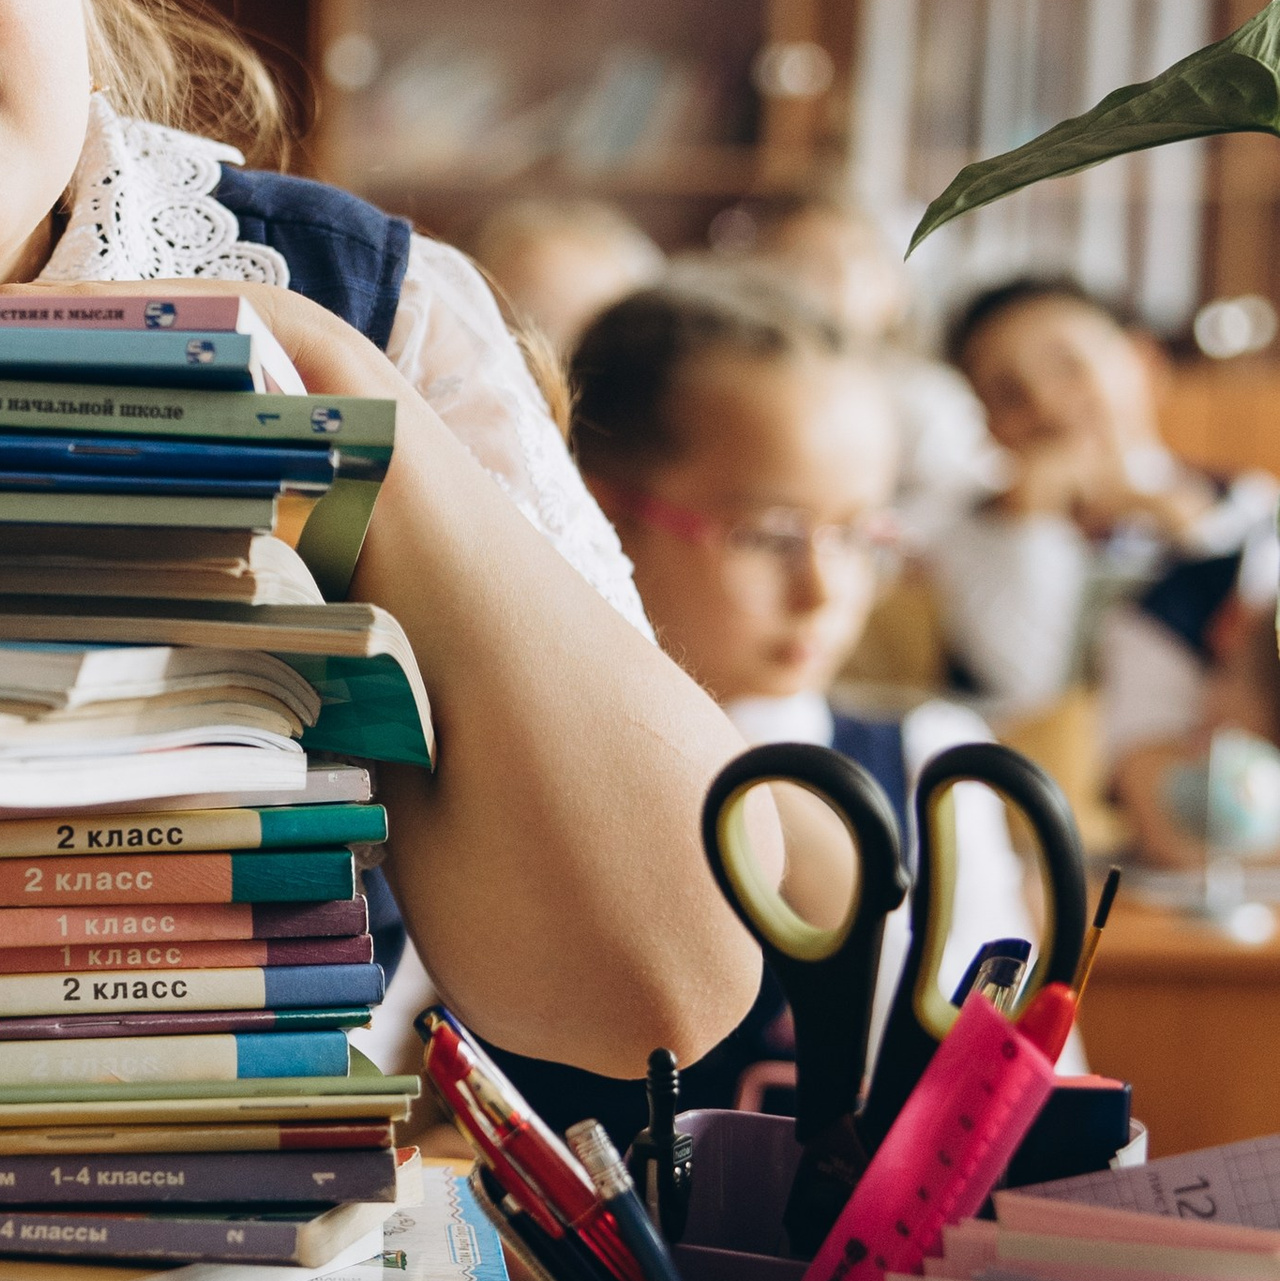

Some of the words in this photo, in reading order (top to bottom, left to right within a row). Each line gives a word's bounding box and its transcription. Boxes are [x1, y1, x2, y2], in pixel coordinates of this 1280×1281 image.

[53, 309, 64, 321] к
[68, 308, 125, 322] мысли
[7, 396, 114, 416] начальной
[120, 403, 184, 421] школе
[256, 412, 280, 426] 1
[56, 825, 75, 849] 2
[87, 826, 184, 848] класс
[24, 867, 43, 893] 2
[55, 869, 154, 892] класс
[56, 914, 69, 937] 1
[84, 913, 176, 936] класс
[59, 945, 71, 966] 1
[87, 944, 182, 967] класс
[62, 977, 81, 1002] 2
[92, 977, 188, 1001] класс
[50, 1167, 90, 1186] 1-4
[98, 1168, 185, 1187] классы
[312, 1170, 335, 1186] 1
[1172, 1173, 1217, 1220] 12
[20, 1222, 108, 1243] классы
[226, 1228, 245, 1245] 2
